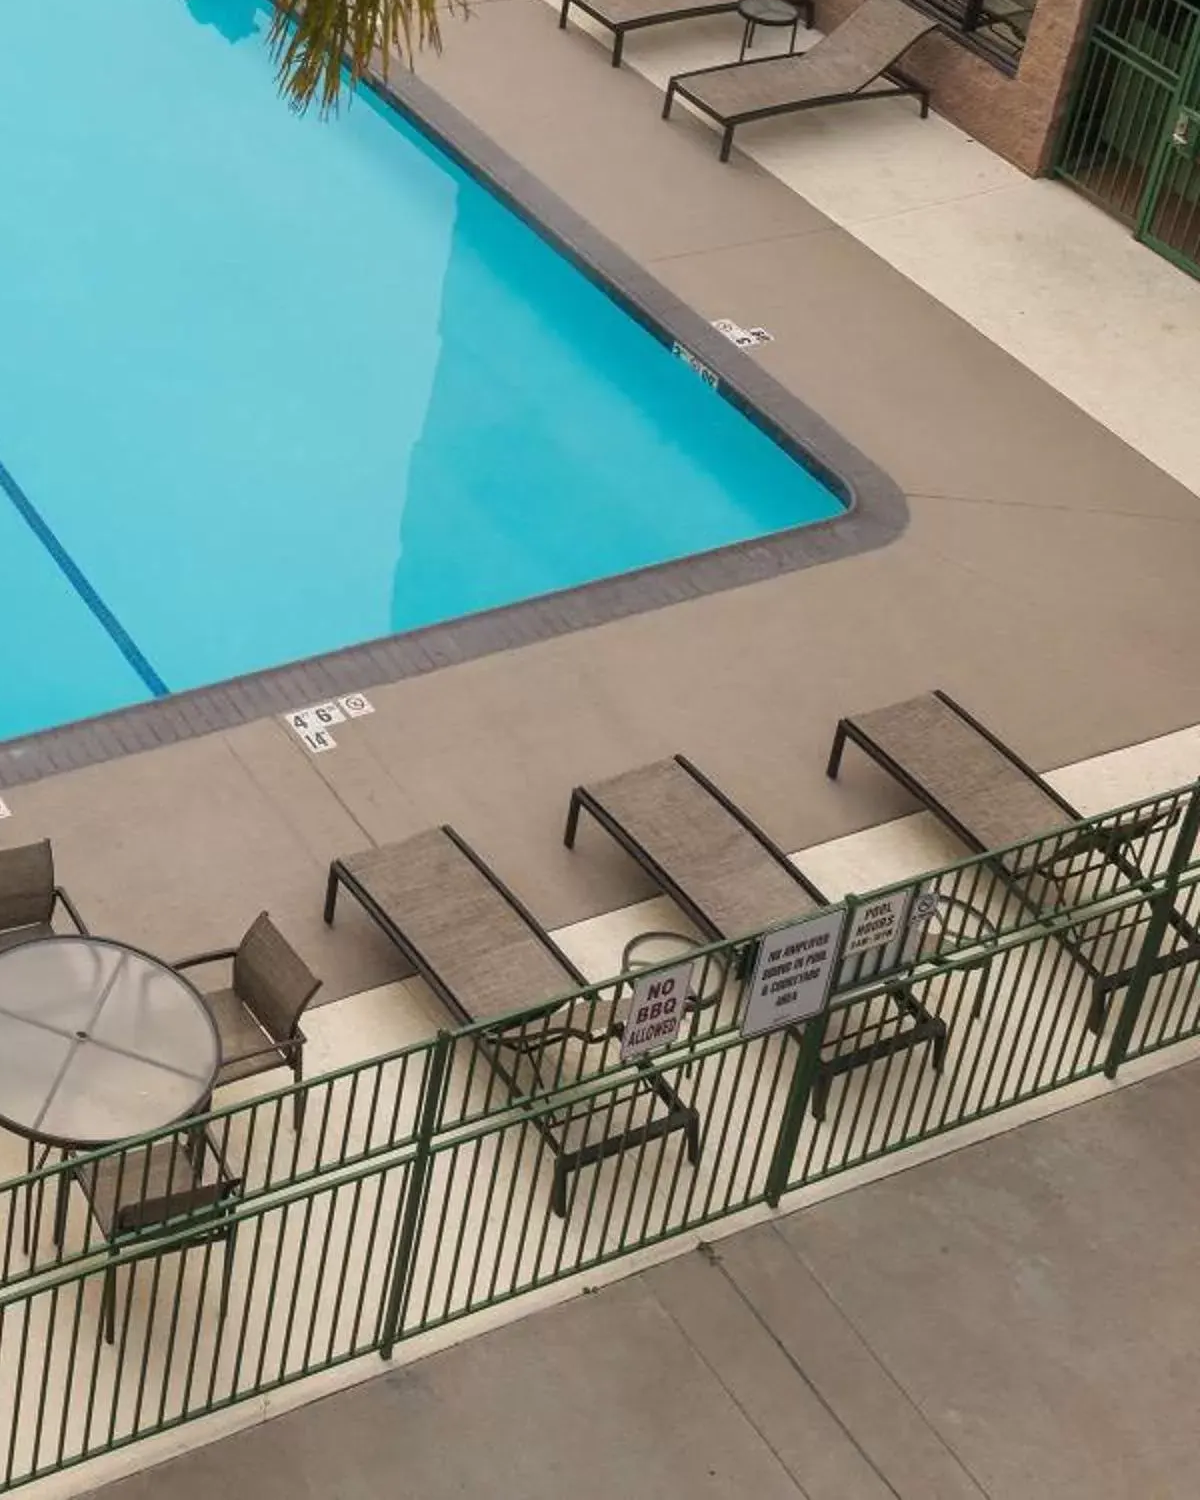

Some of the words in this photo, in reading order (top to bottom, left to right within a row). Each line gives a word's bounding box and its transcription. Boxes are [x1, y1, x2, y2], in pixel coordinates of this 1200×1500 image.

[294, 715, 308, 729] 4
[316, 708, 332, 722] 6
[865, 901, 892, 920] POOL
[647, 978, 675, 1001] NO
[636, 998, 677, 1024] BBQ
[628, 1016, 677, 1047] ALLOWED
